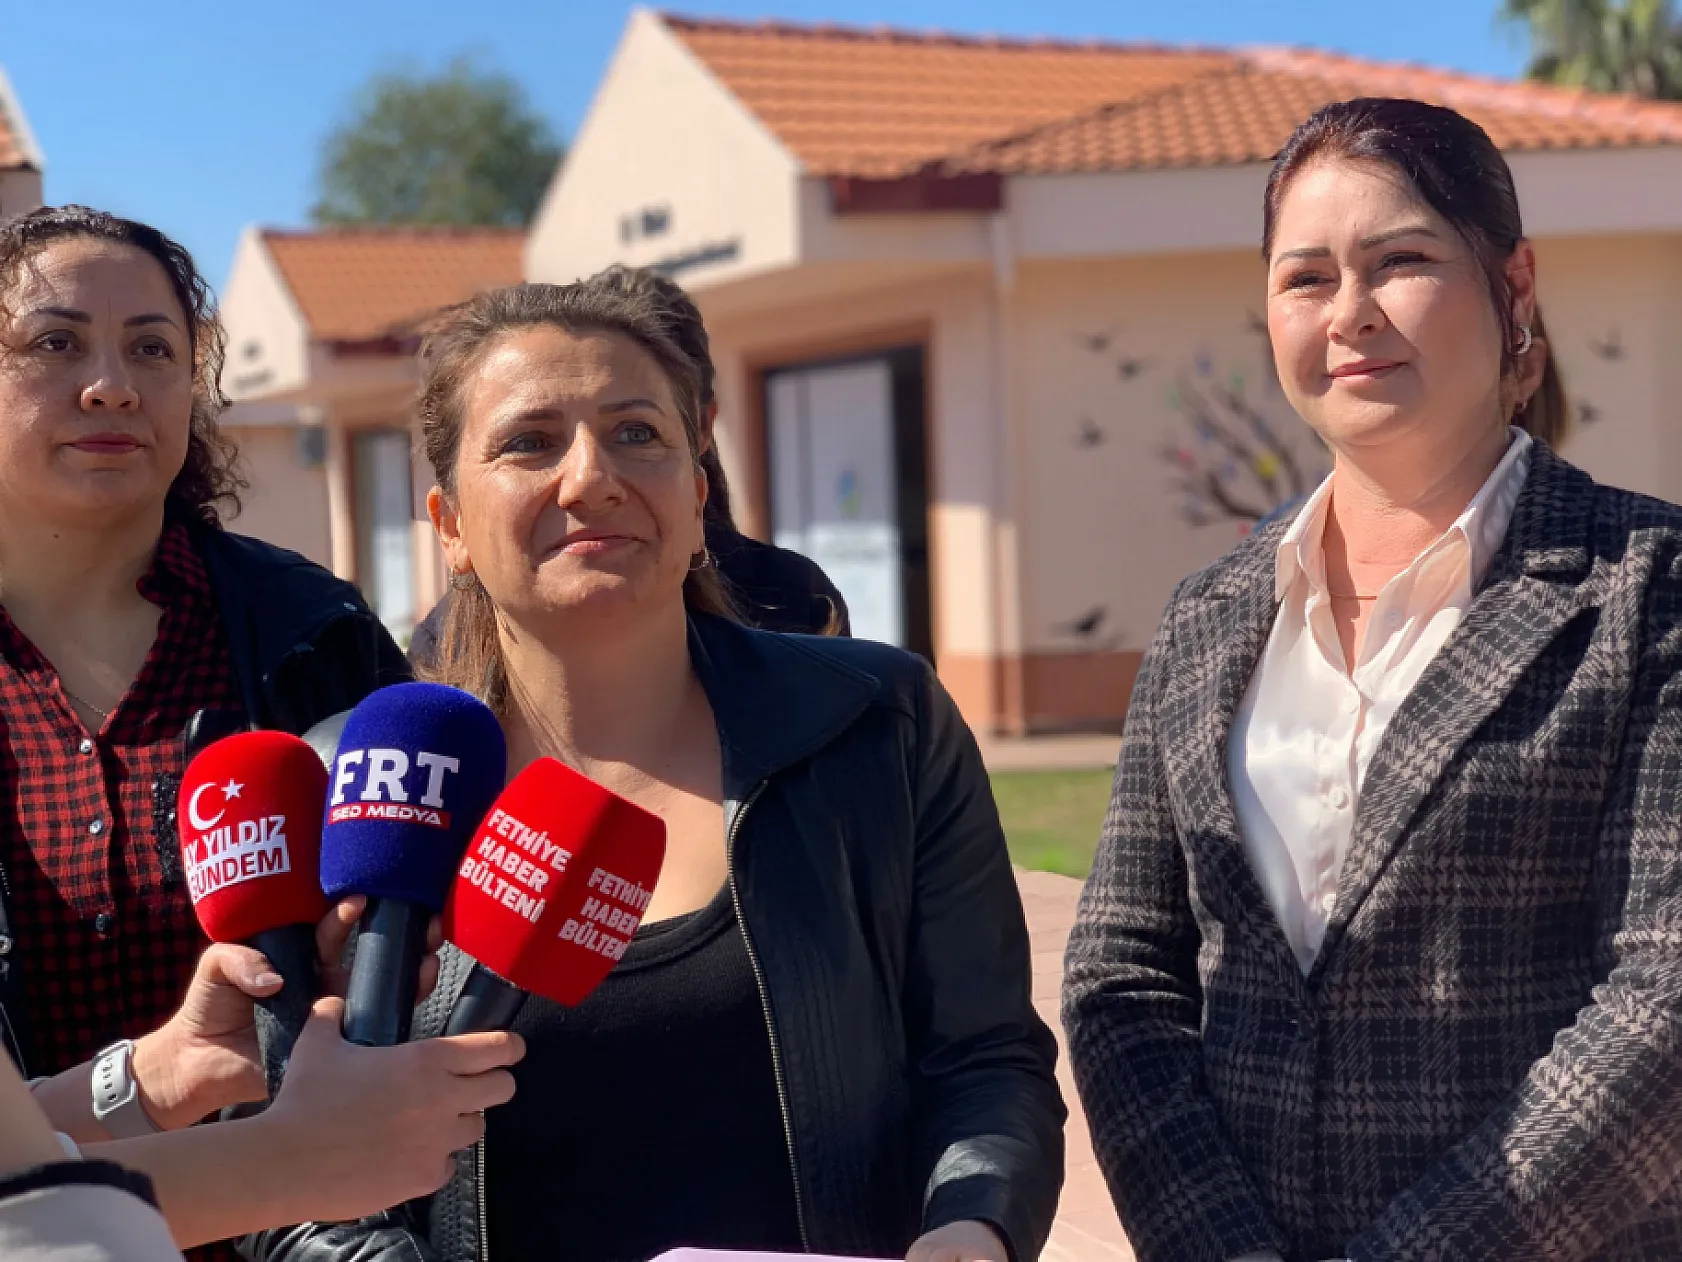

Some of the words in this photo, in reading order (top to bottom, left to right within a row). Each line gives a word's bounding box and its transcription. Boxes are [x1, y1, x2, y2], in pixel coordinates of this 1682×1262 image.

[331, 748, 459, 808] FRT
[202, 815, 286, 857] YILDIZ
[366, 805, 442, 825] MEDYA
[487, 808, 572, 872] FETHİYE
[477, 836, 549, 892] HABER
[459, 856, 546, 923] BÜLTENİ
[587, 867, 653, 912] FETHİY
[558, 918, 631, 961] BÜLTEN
